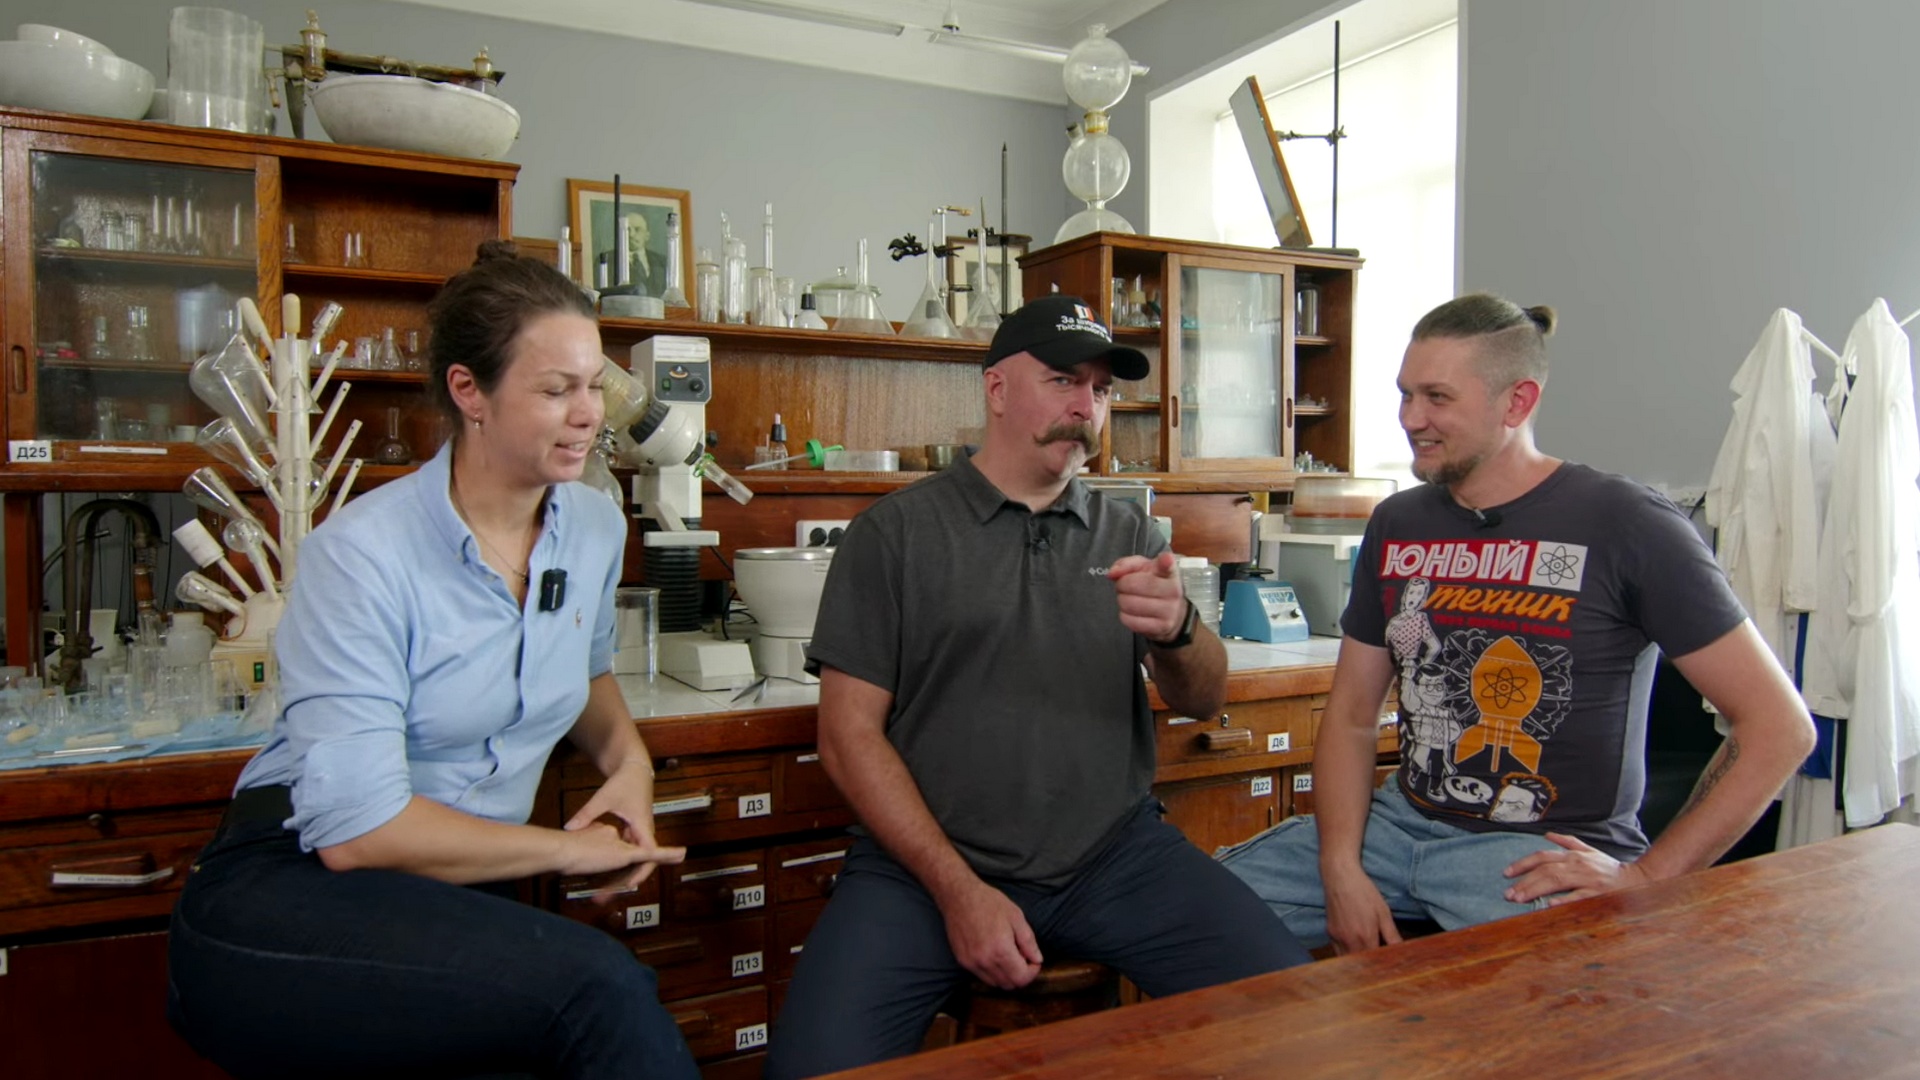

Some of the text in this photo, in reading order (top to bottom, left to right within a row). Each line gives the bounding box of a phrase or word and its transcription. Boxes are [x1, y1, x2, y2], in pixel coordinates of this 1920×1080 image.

[17, 446, 48, 459] Д25
[1382, 539, 1530, 582] ЮНЫЙ
[1272, 737, 1285, 749] Д6
[1252, 781, 1270, 793] Д22
[1296, 778, 1312, 789] Д2
[745, 799, 764, 815] Д3
[735, 890, 762, 907] Д10
[632, 910, 652, 926] Д9
[734, 957, 760, 973] Д13
[738, 1029, 764, 1047] Д15
